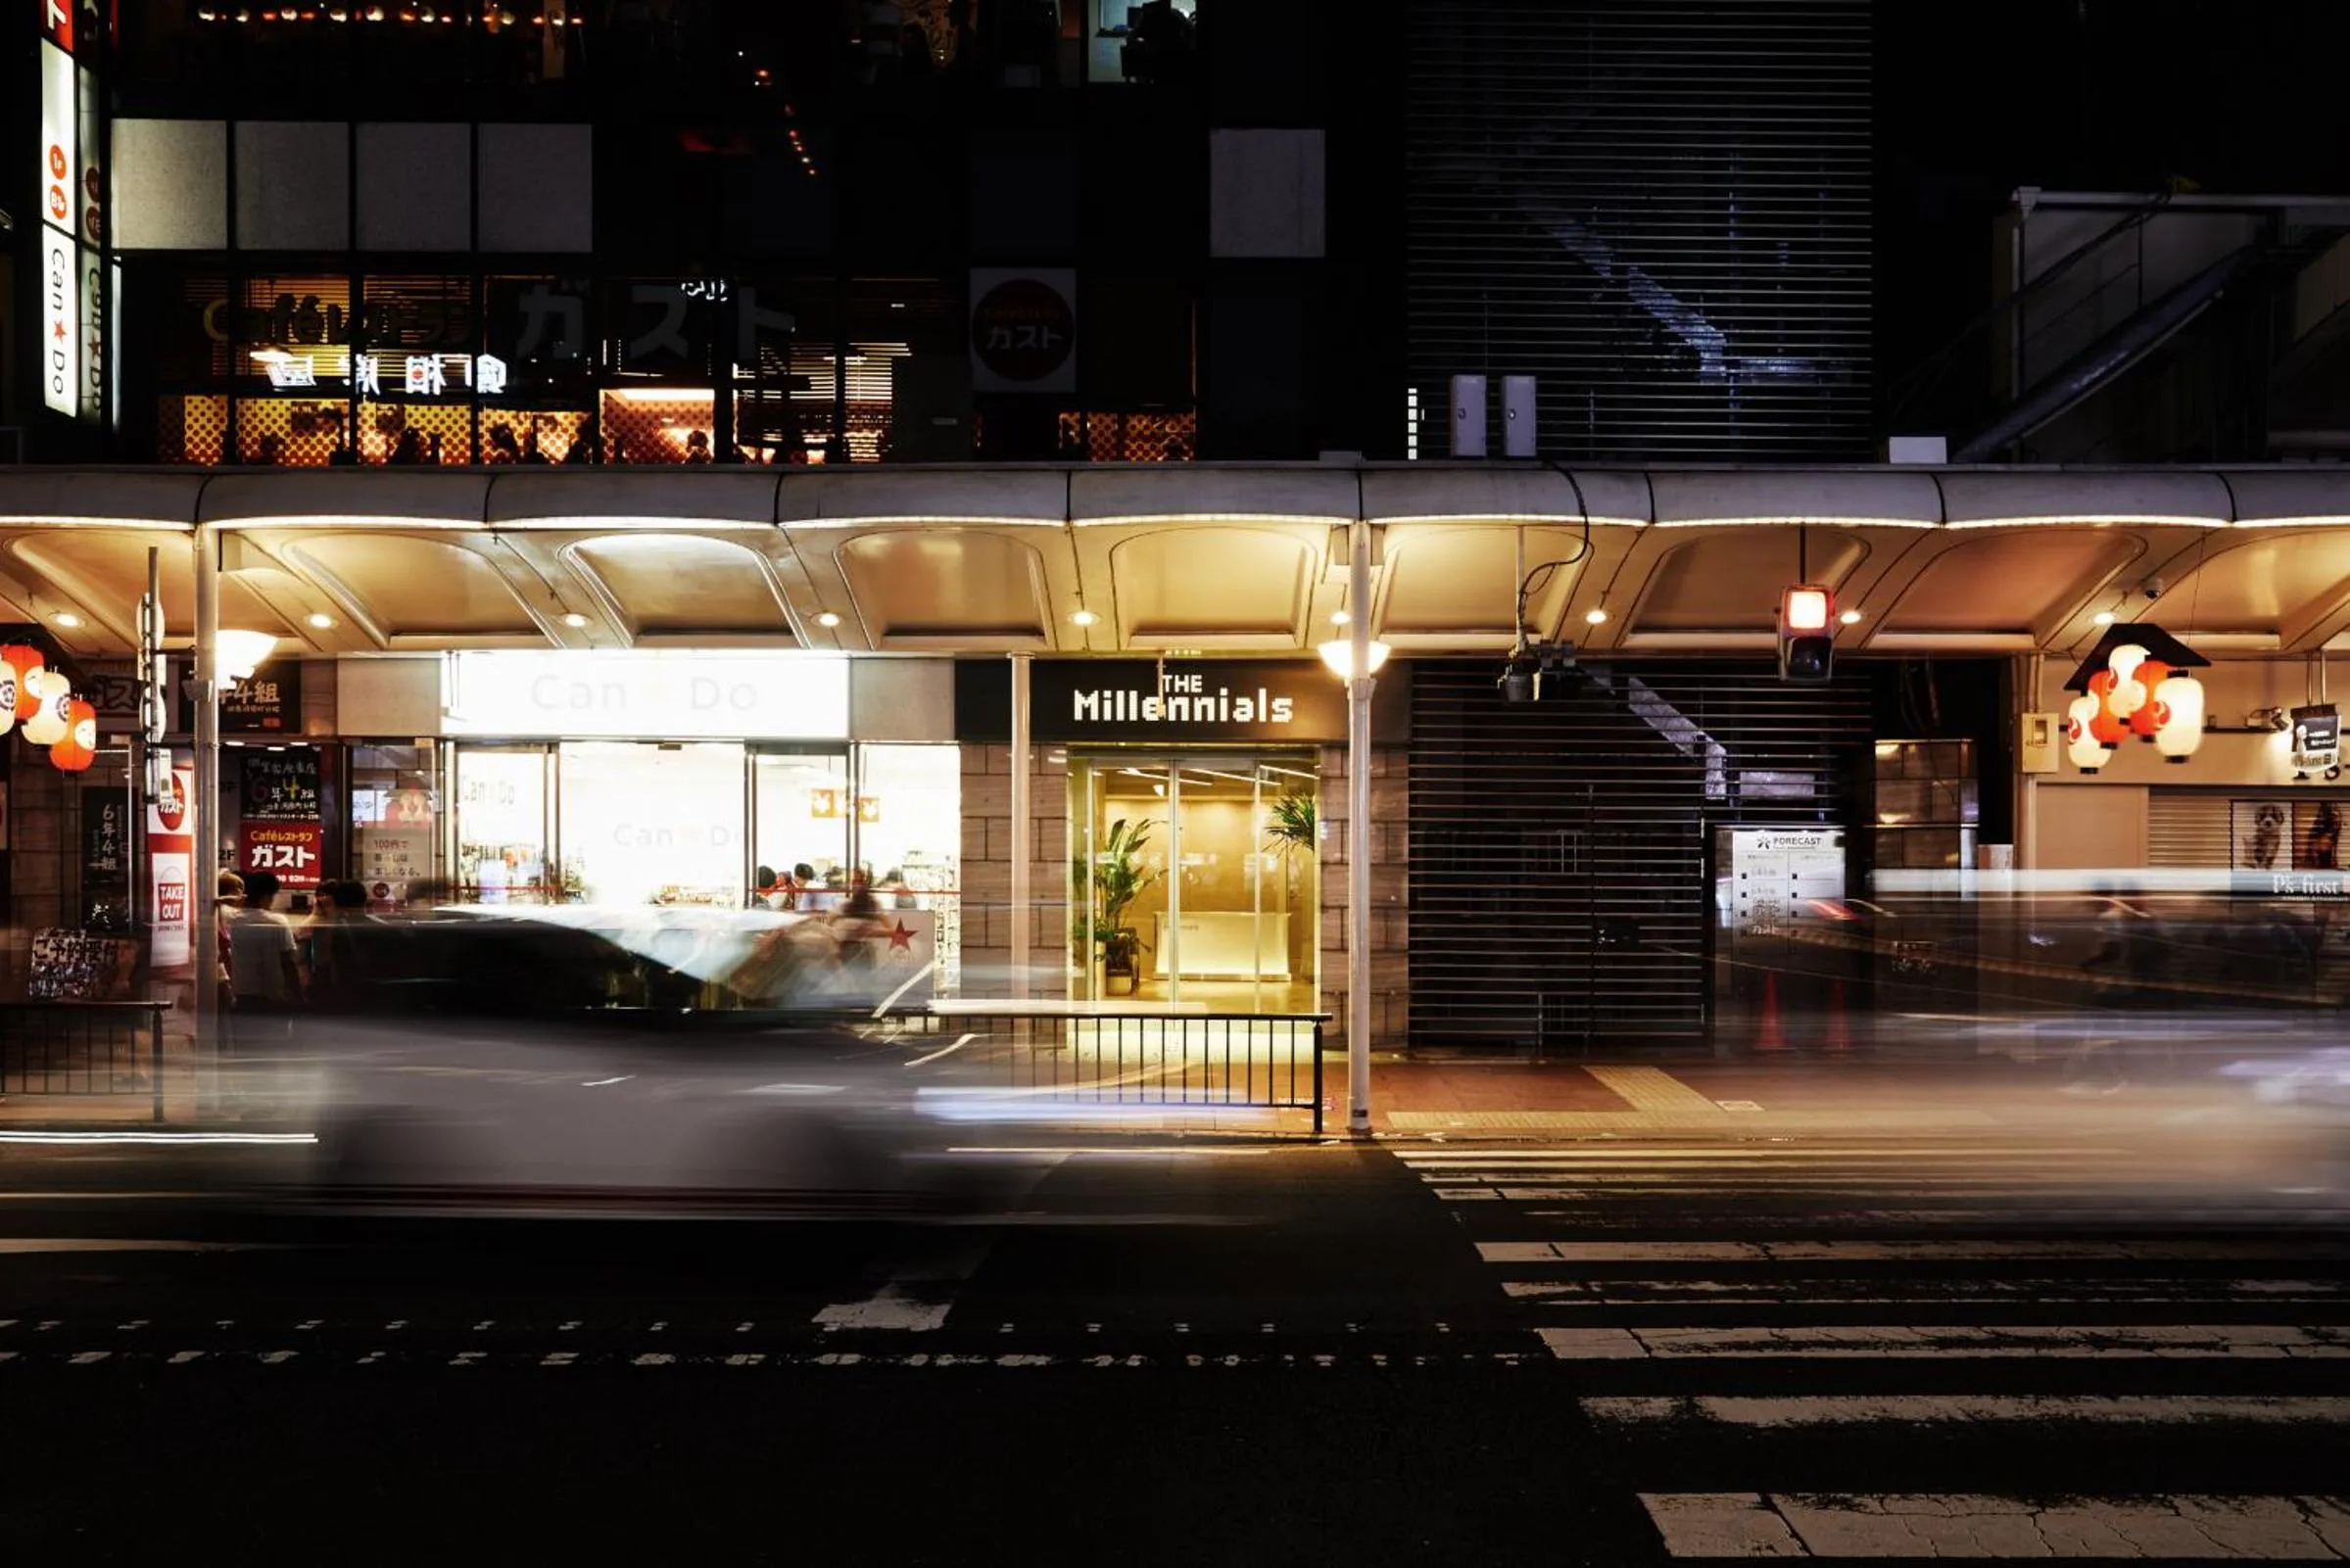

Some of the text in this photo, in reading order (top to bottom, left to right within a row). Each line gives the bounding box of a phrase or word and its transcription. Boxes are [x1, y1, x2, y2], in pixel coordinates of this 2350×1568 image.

[52, 248, 66, 395] Can Do
[516, 279, 796, 359] ガスト
[531, 673, 759, 712] Can Do
[1163, 675, 1203, 693] THE
[1074, 688, 1294, 723] Millennials
[613, 823, 674, 848] Can
[251, 844, 316, 869] ガスト
[160, 885, 184, 900] TAKE
[162, 904, 180, 919] OUT
